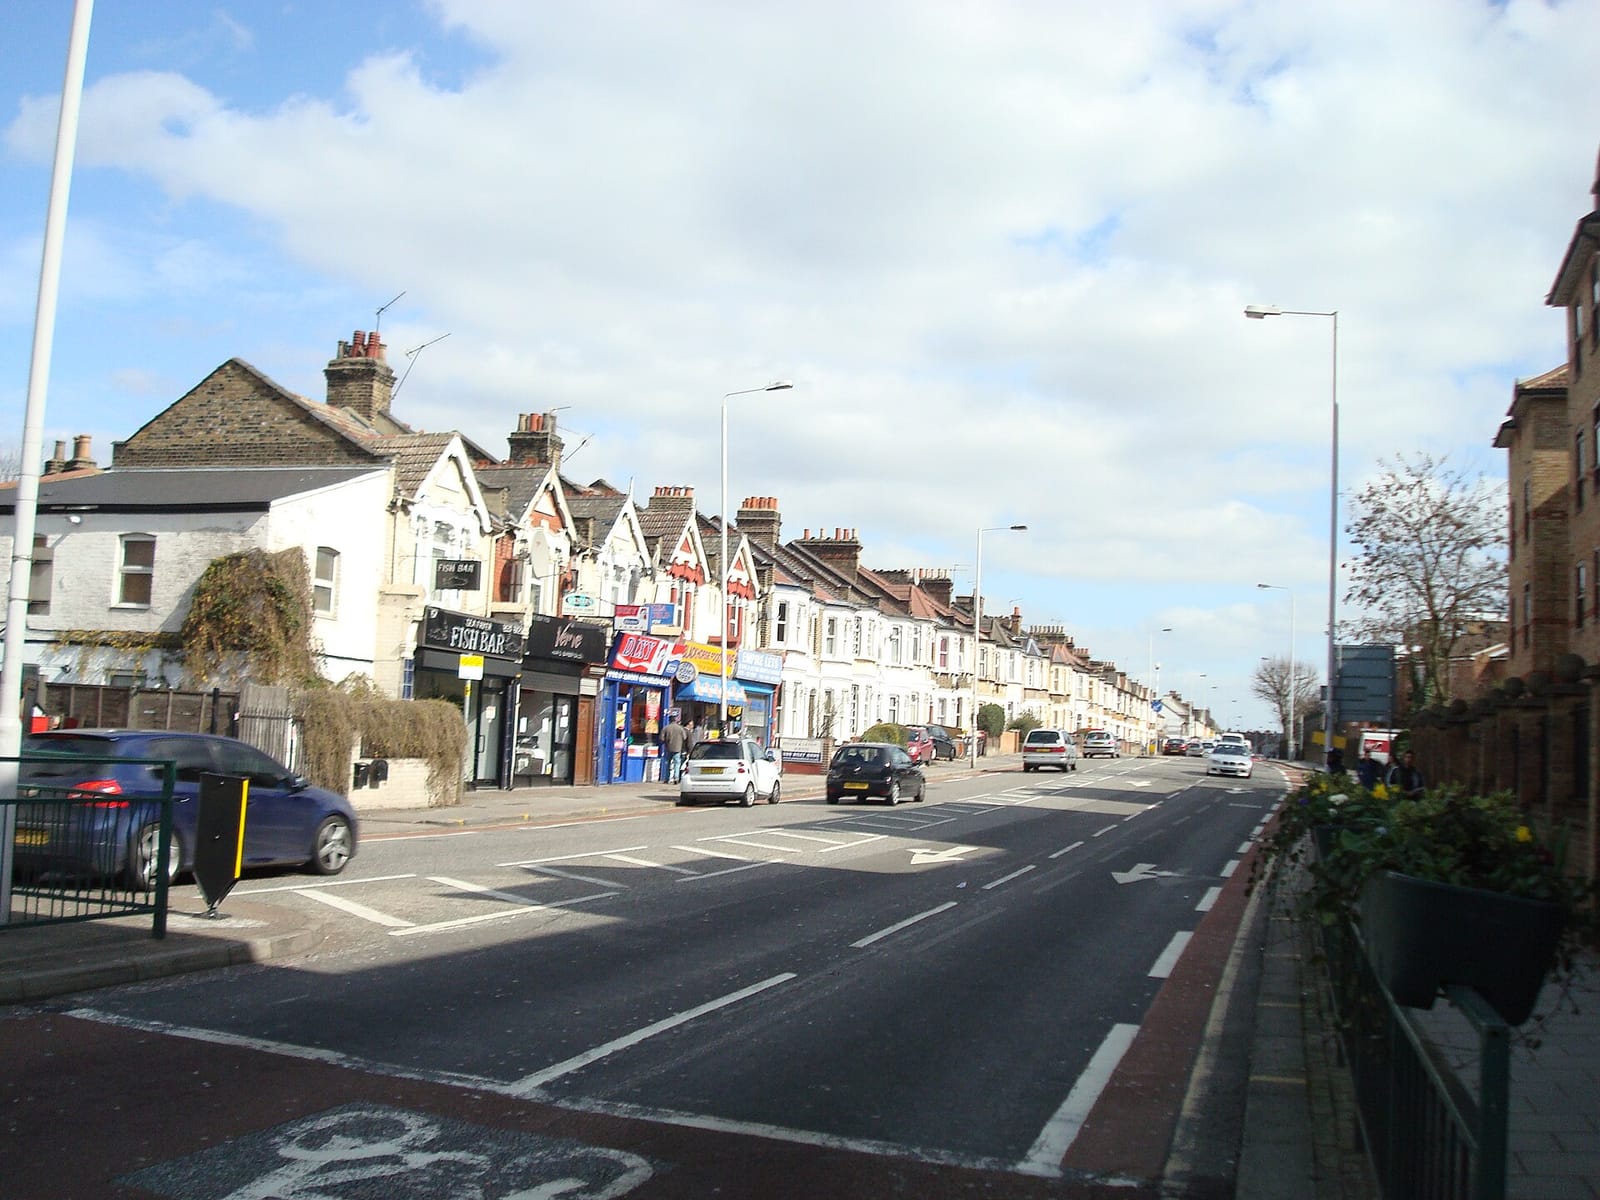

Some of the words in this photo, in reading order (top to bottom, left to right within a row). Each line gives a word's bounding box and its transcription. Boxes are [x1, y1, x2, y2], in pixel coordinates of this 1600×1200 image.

[438, 563, 456, 573] FISH
[457, 563, 475, 573] BAR
[449, 625, 480, 651] FISH
[480, 631, 506, 654] BAR
[622, 637, 657, 660] DIXY
